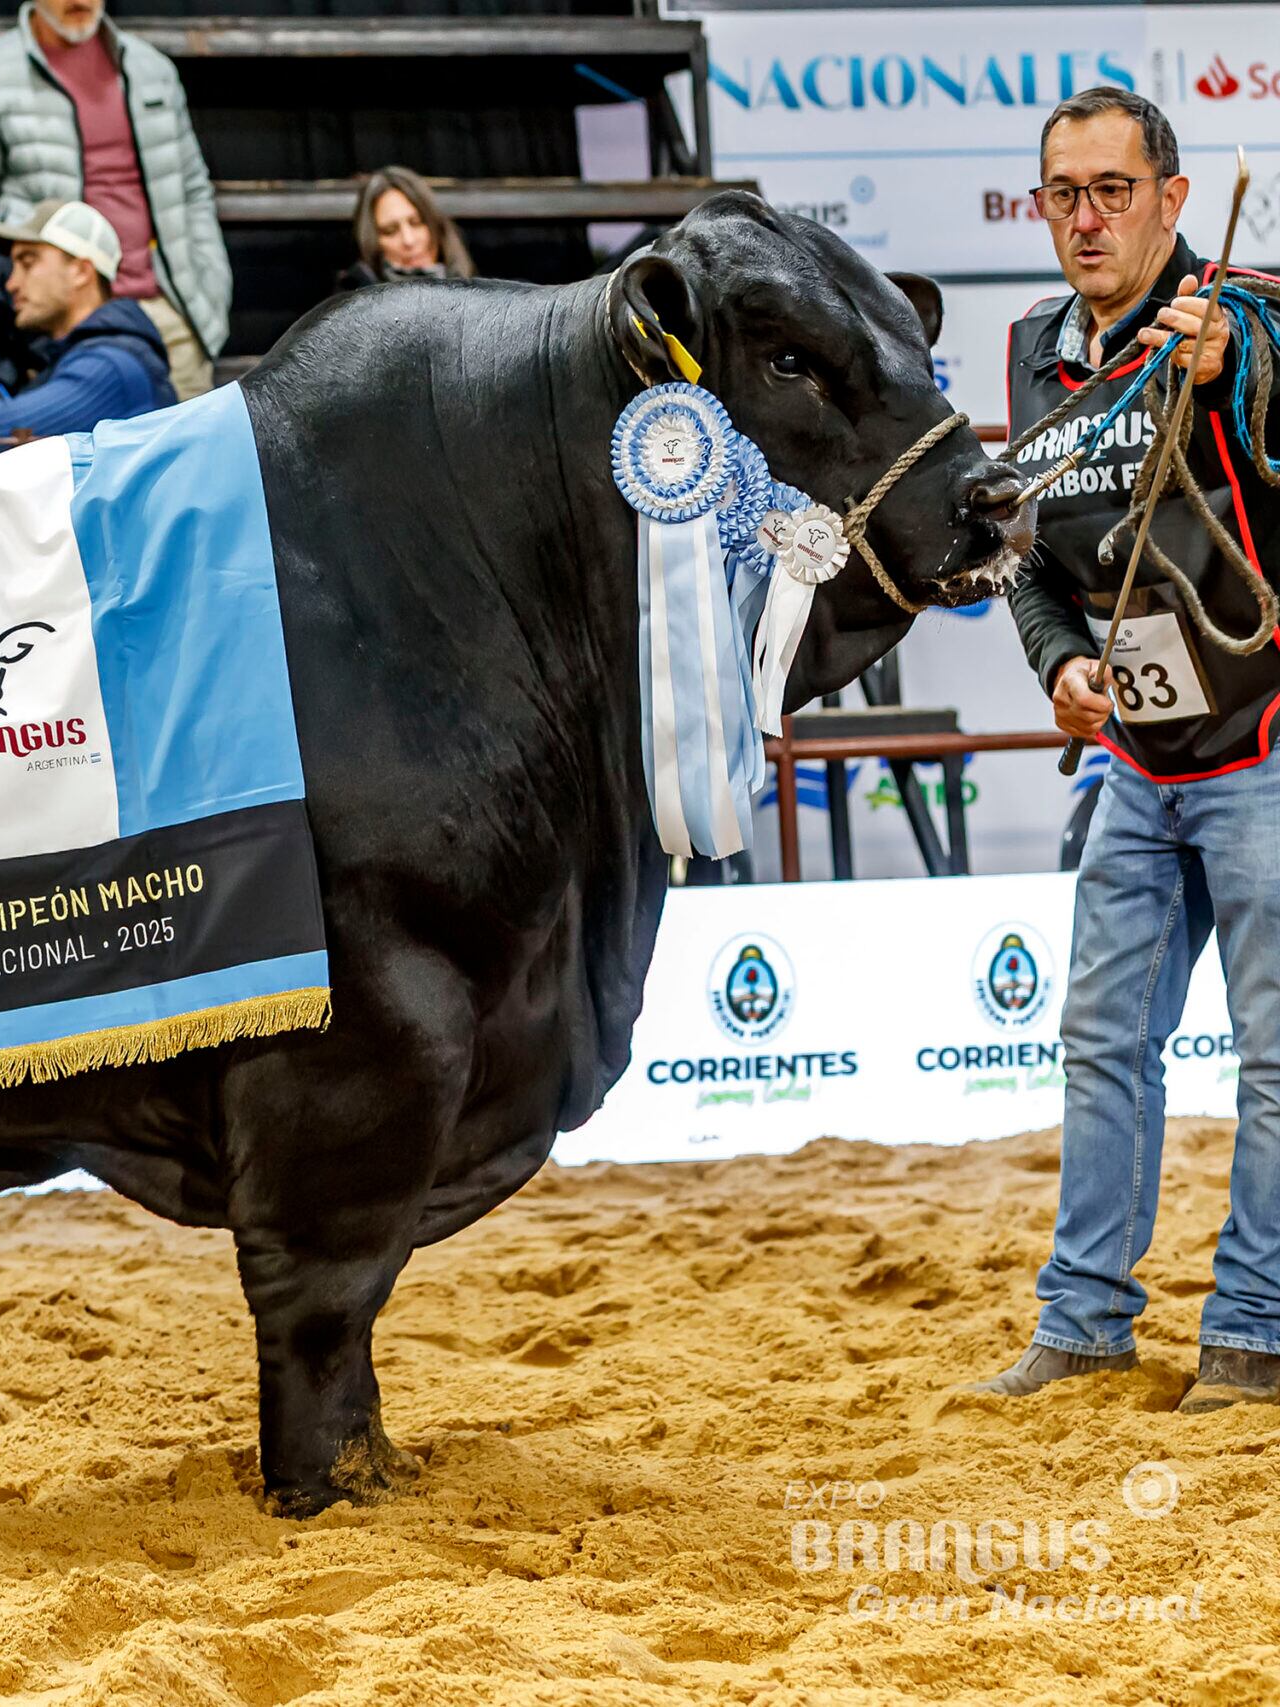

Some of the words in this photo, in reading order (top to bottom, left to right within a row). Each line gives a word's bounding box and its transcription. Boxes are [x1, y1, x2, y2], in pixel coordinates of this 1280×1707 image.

[708, 51, 1135, 111] NACIONALES
[797, 542, 824, 561] BRANGUS
[1111, 663, 1178, 711] 83
[27, 755, 89, 771] ARGENTINA
[97, 863, 205, 912] MACHO
[117, 916, 175, 952] 2025
[646, 1051, 858, 1085] CORRIENTES
[917, 1042, 1065, 1071] CORRIEN
